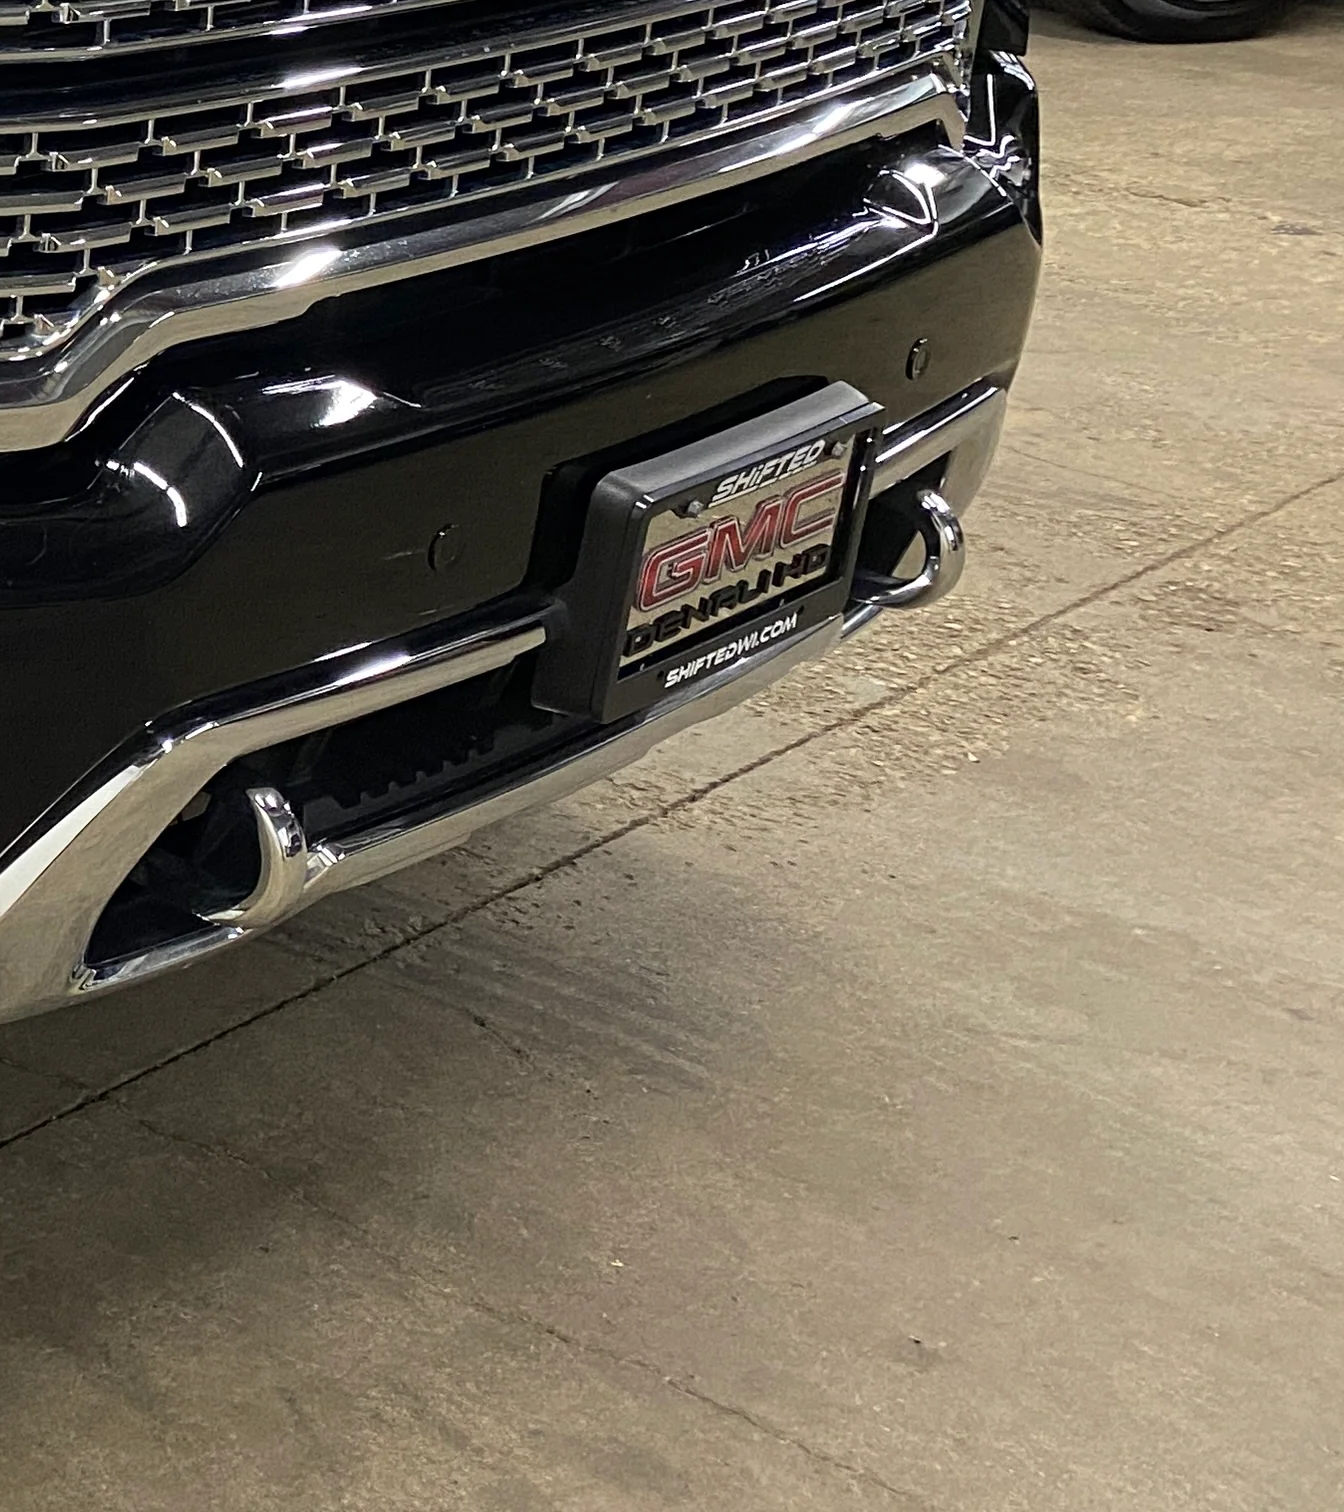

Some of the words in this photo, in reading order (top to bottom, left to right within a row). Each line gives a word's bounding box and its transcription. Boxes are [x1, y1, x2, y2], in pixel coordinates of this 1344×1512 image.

[637, 469, 846, 612] GMC
[623, 568, 771, 658] DENALI
[771, 544, 831, 587] HD
[663, 612, 799, 688] SHIFTEDWI.COM
